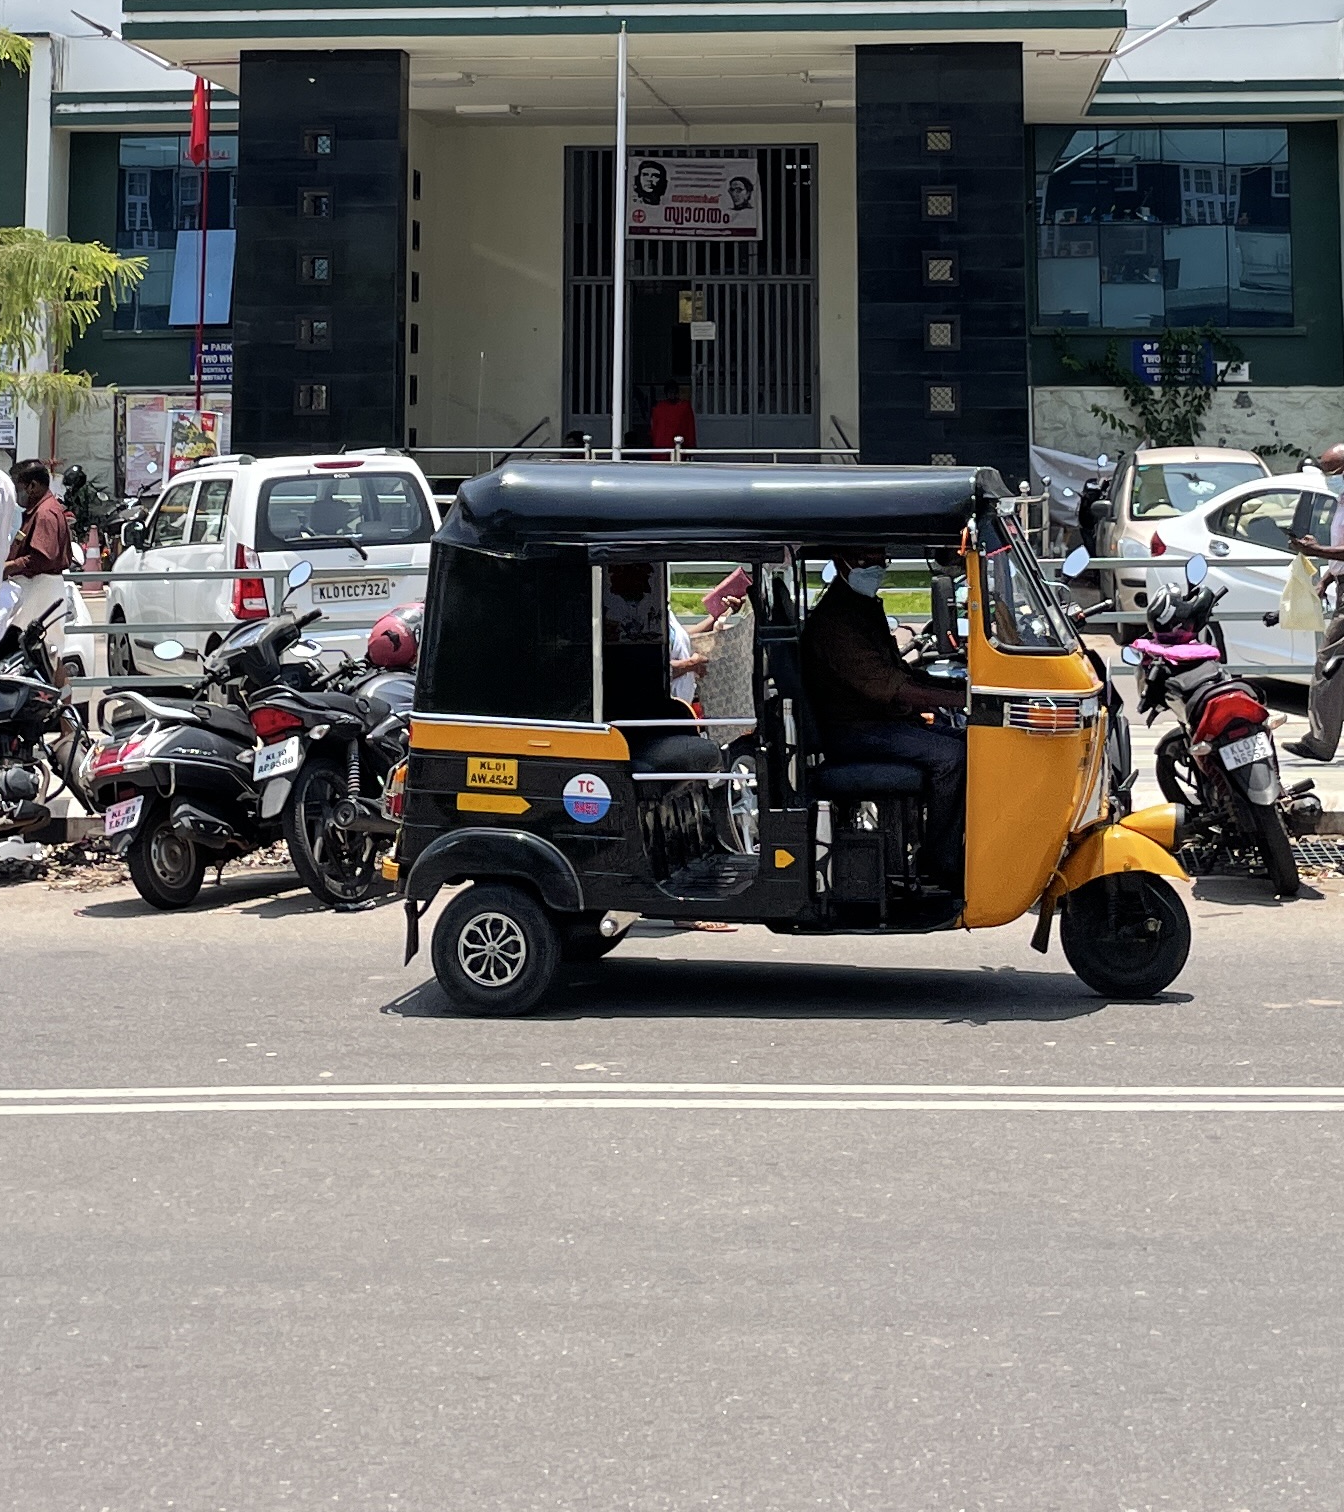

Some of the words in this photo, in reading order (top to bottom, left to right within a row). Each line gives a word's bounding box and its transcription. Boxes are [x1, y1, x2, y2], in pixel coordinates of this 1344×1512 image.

[664, 206, 730, 225] സ്വാഗതം
[1142, 354, 1161, 364] TWO
[319, 582, 388, 599] KL01CC7324
[578, 780, 595, 793] TC
